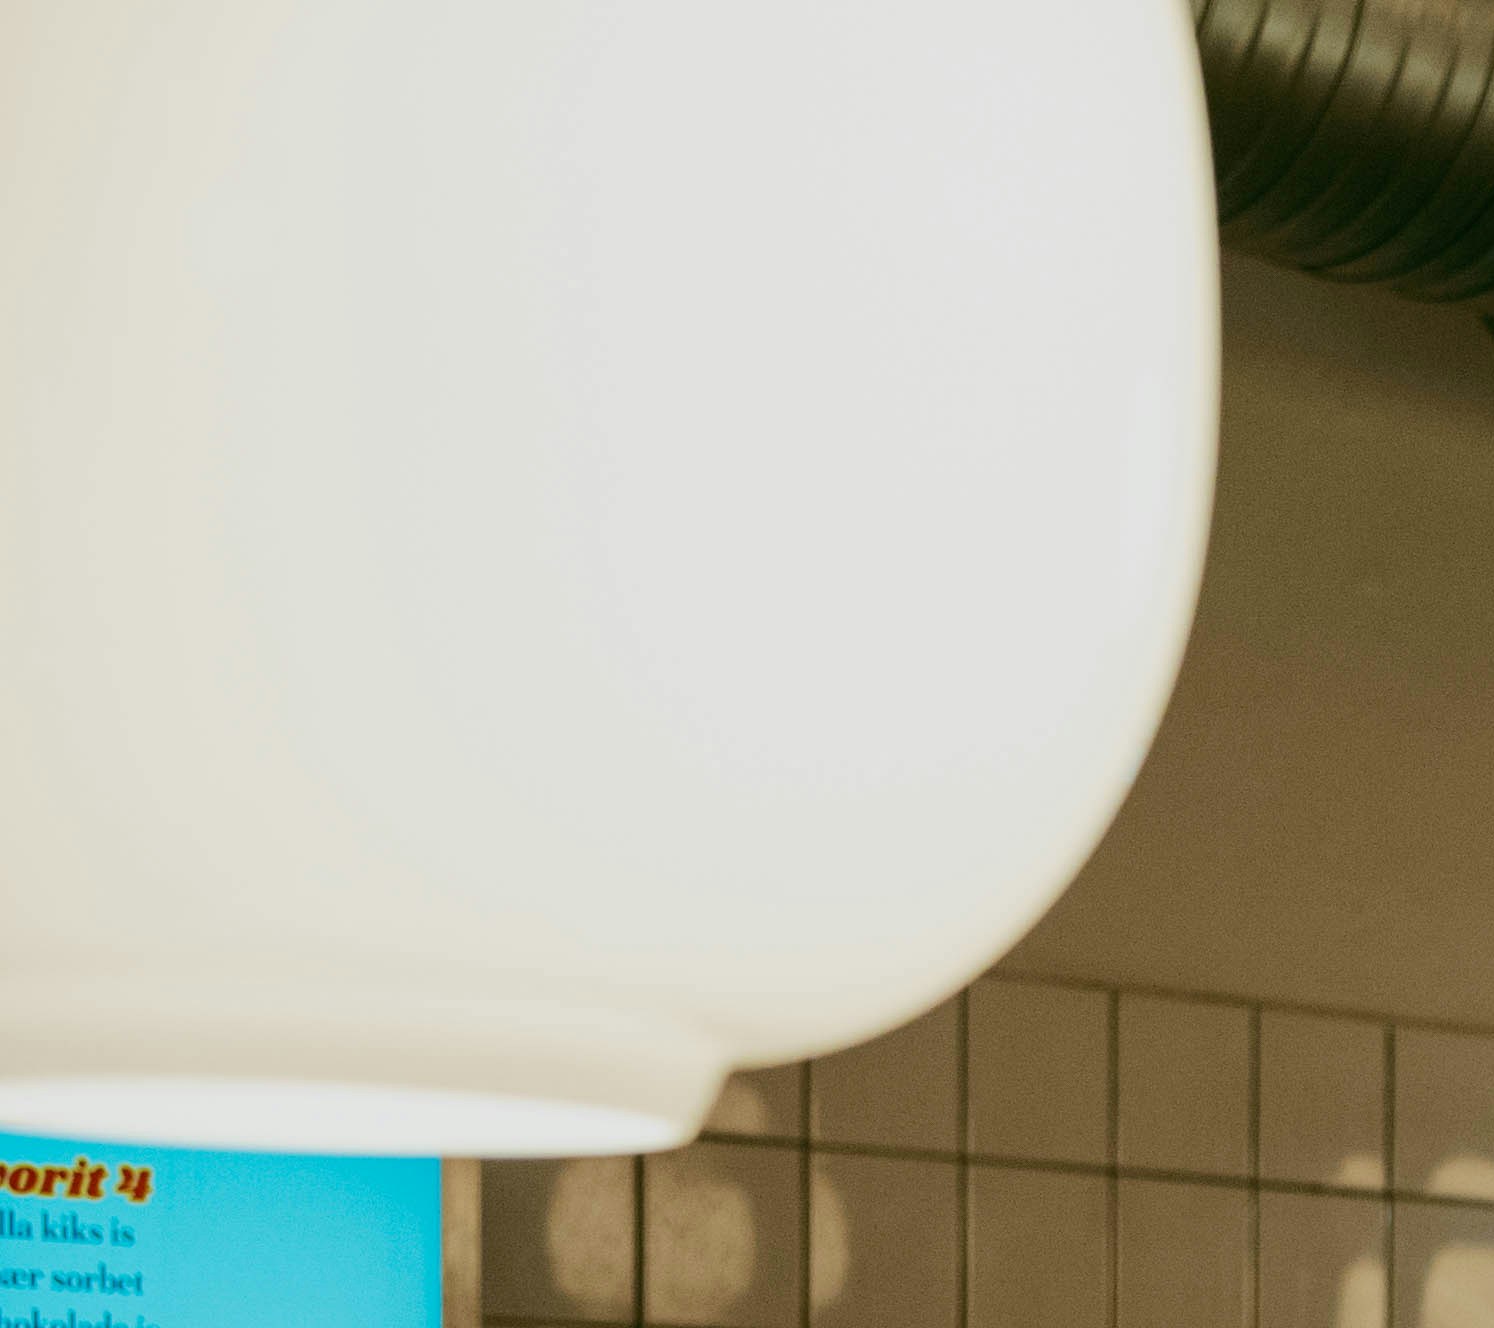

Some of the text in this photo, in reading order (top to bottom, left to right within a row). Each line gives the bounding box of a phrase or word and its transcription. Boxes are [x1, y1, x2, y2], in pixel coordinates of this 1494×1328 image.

[115, 1164, 152, 1201] 4
[41, 1208, 103, 1244] kiks
[109, 1216, 135, 1246] is
[51, 1260, 143, 1296] sorbet
